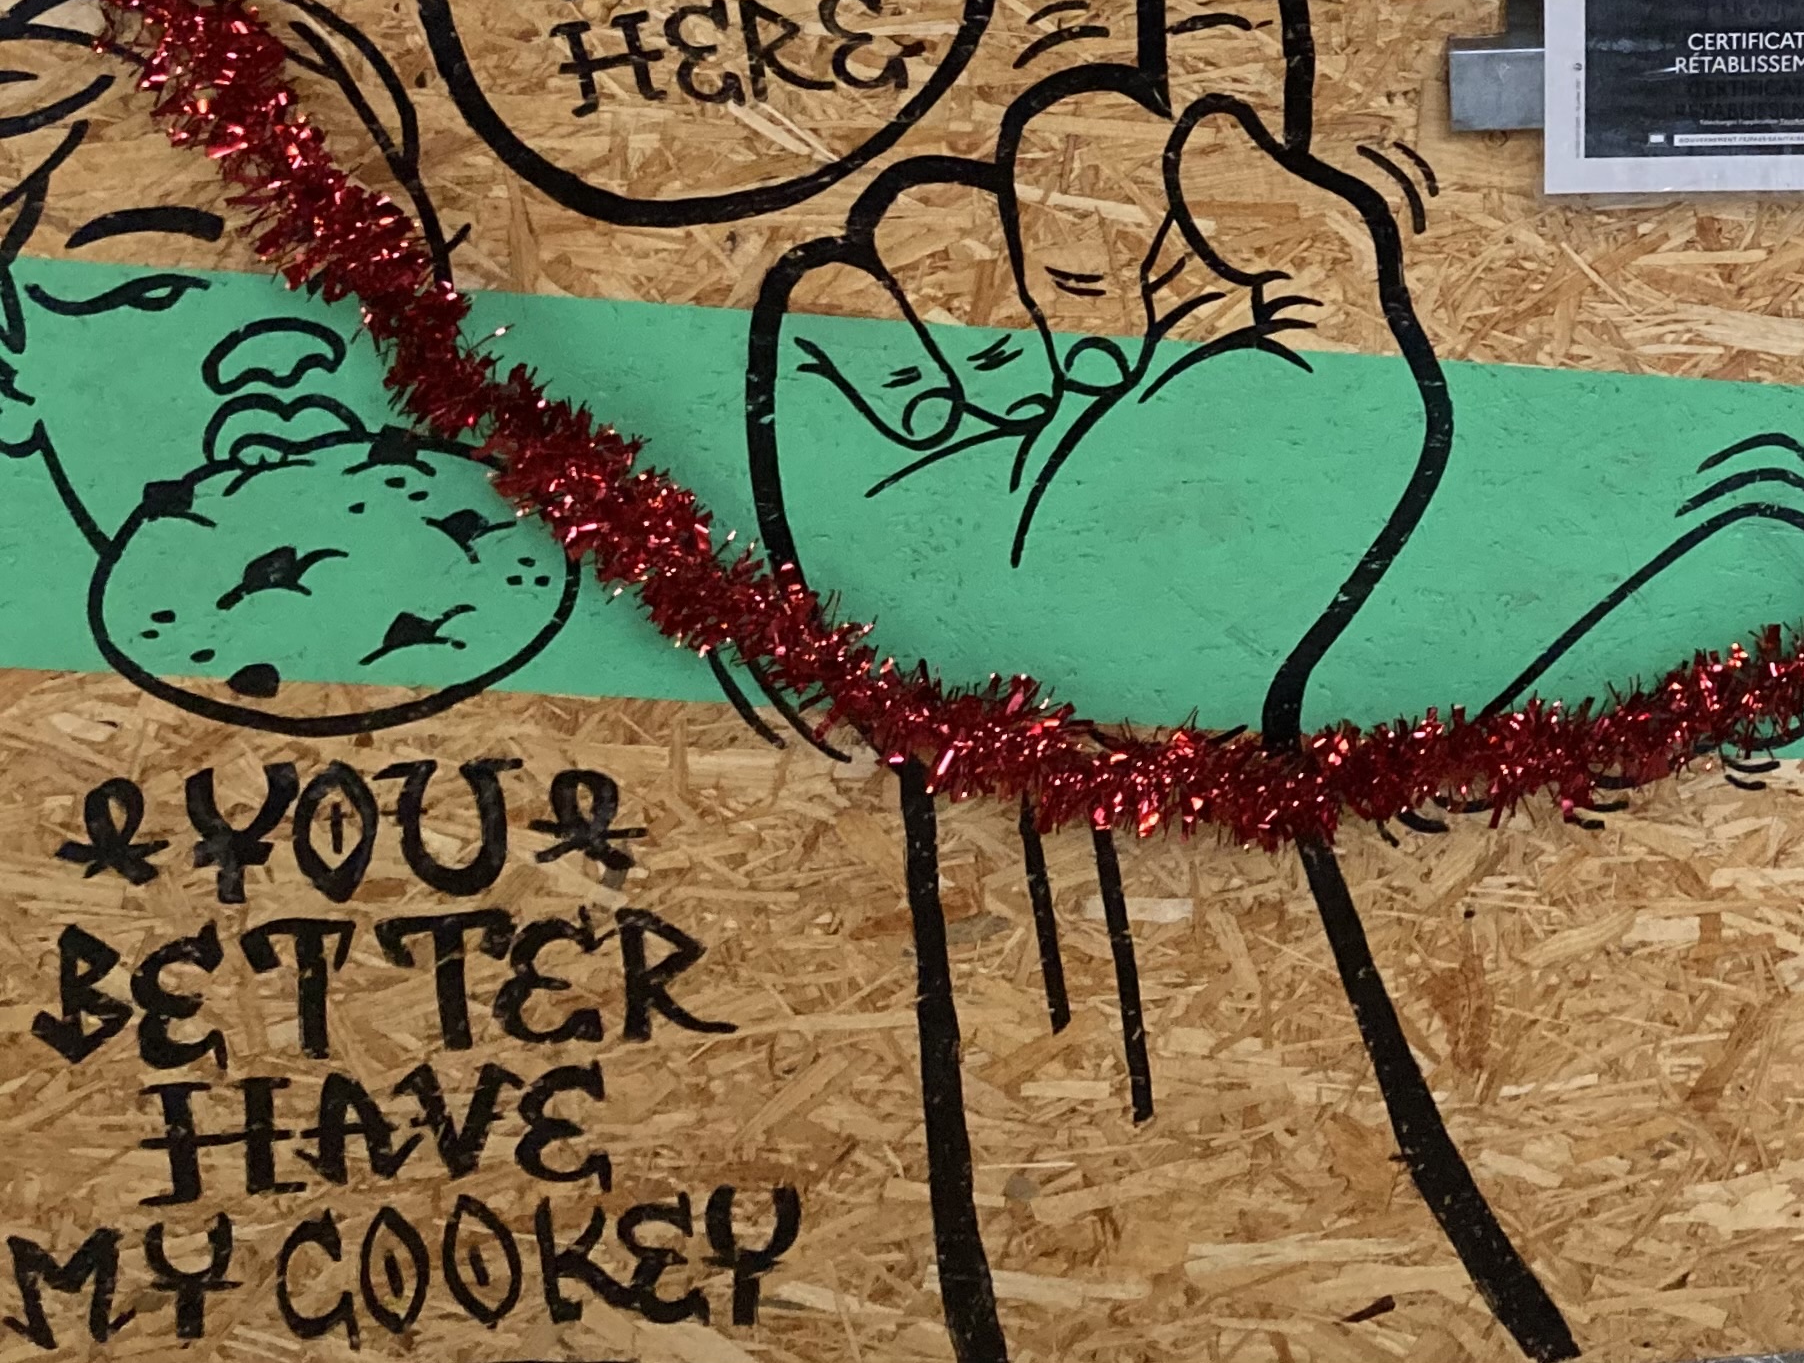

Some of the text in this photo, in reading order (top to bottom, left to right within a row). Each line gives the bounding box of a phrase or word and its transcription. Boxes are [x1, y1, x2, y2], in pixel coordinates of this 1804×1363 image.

[30, 905, 739, 1071] BETTER
[139, 1061, 613, 1207] HAVE
[2, 1186, 801, 1350] MY COOKEY
